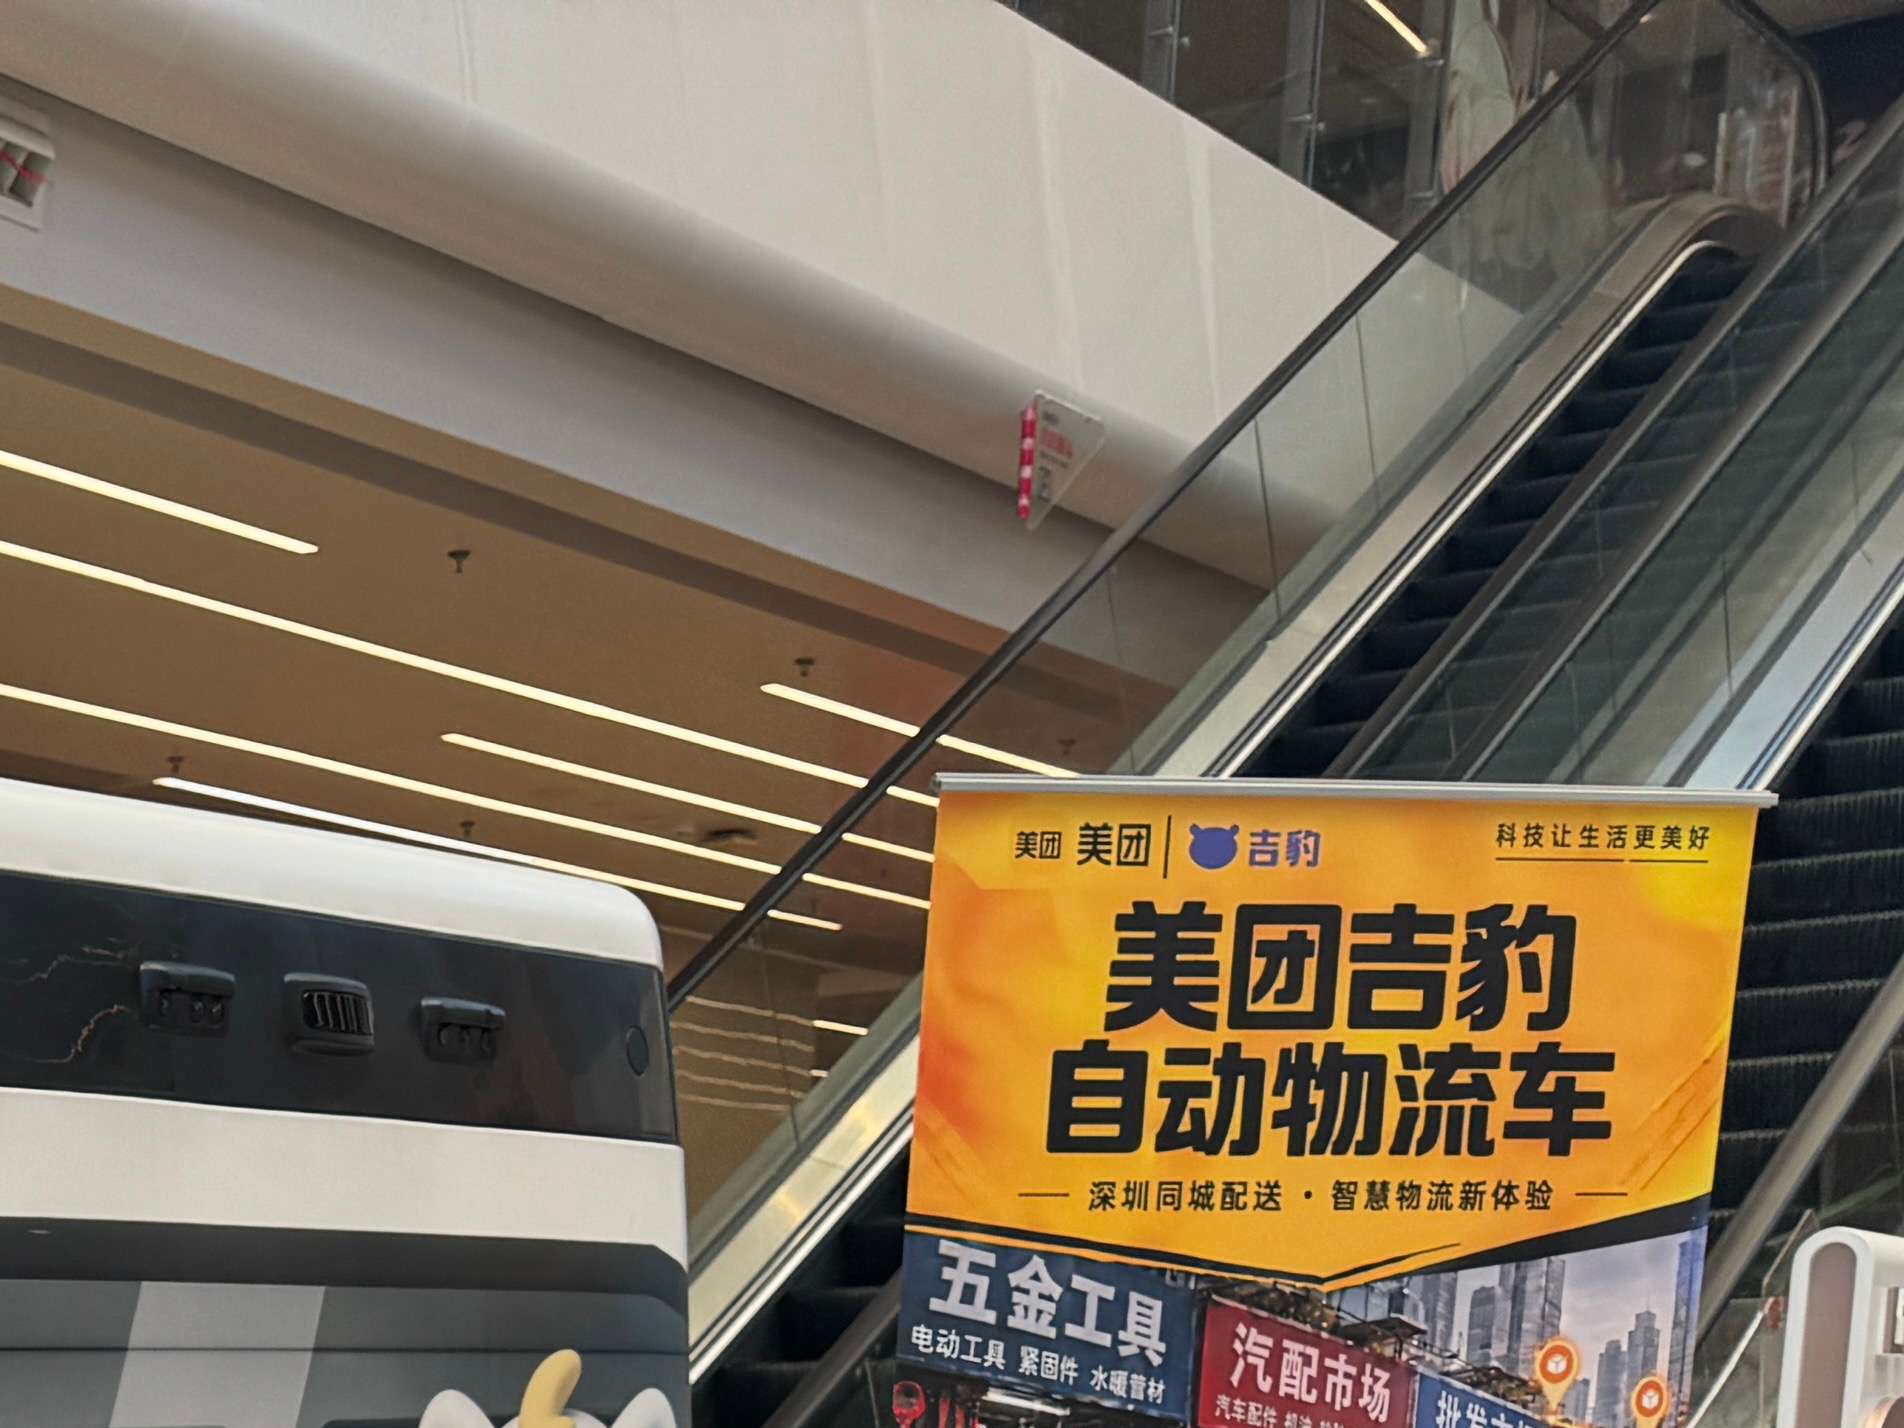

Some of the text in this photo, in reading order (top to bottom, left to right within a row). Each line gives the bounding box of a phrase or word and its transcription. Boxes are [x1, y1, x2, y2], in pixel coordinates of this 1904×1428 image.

[1015, 822, 1321, 868] 美团 美团 吉豹
[1495, 822, 1712, 852] 科技让生活更美好
[1103, 900, 1578, 1033] 美团吉豹
[1045, 1038, 1616, 1158] 自动物流车
[1088, 1179, 1555, 1213] 深圳同城配送 智慧物流新体验
[929, 1239, 1167, 1367] 五金工具
[911, 1323, 1166, 1404] 电动工具 紧固件 水暖管材
[1230, 1322, 1391, 1423] 汽配市场
